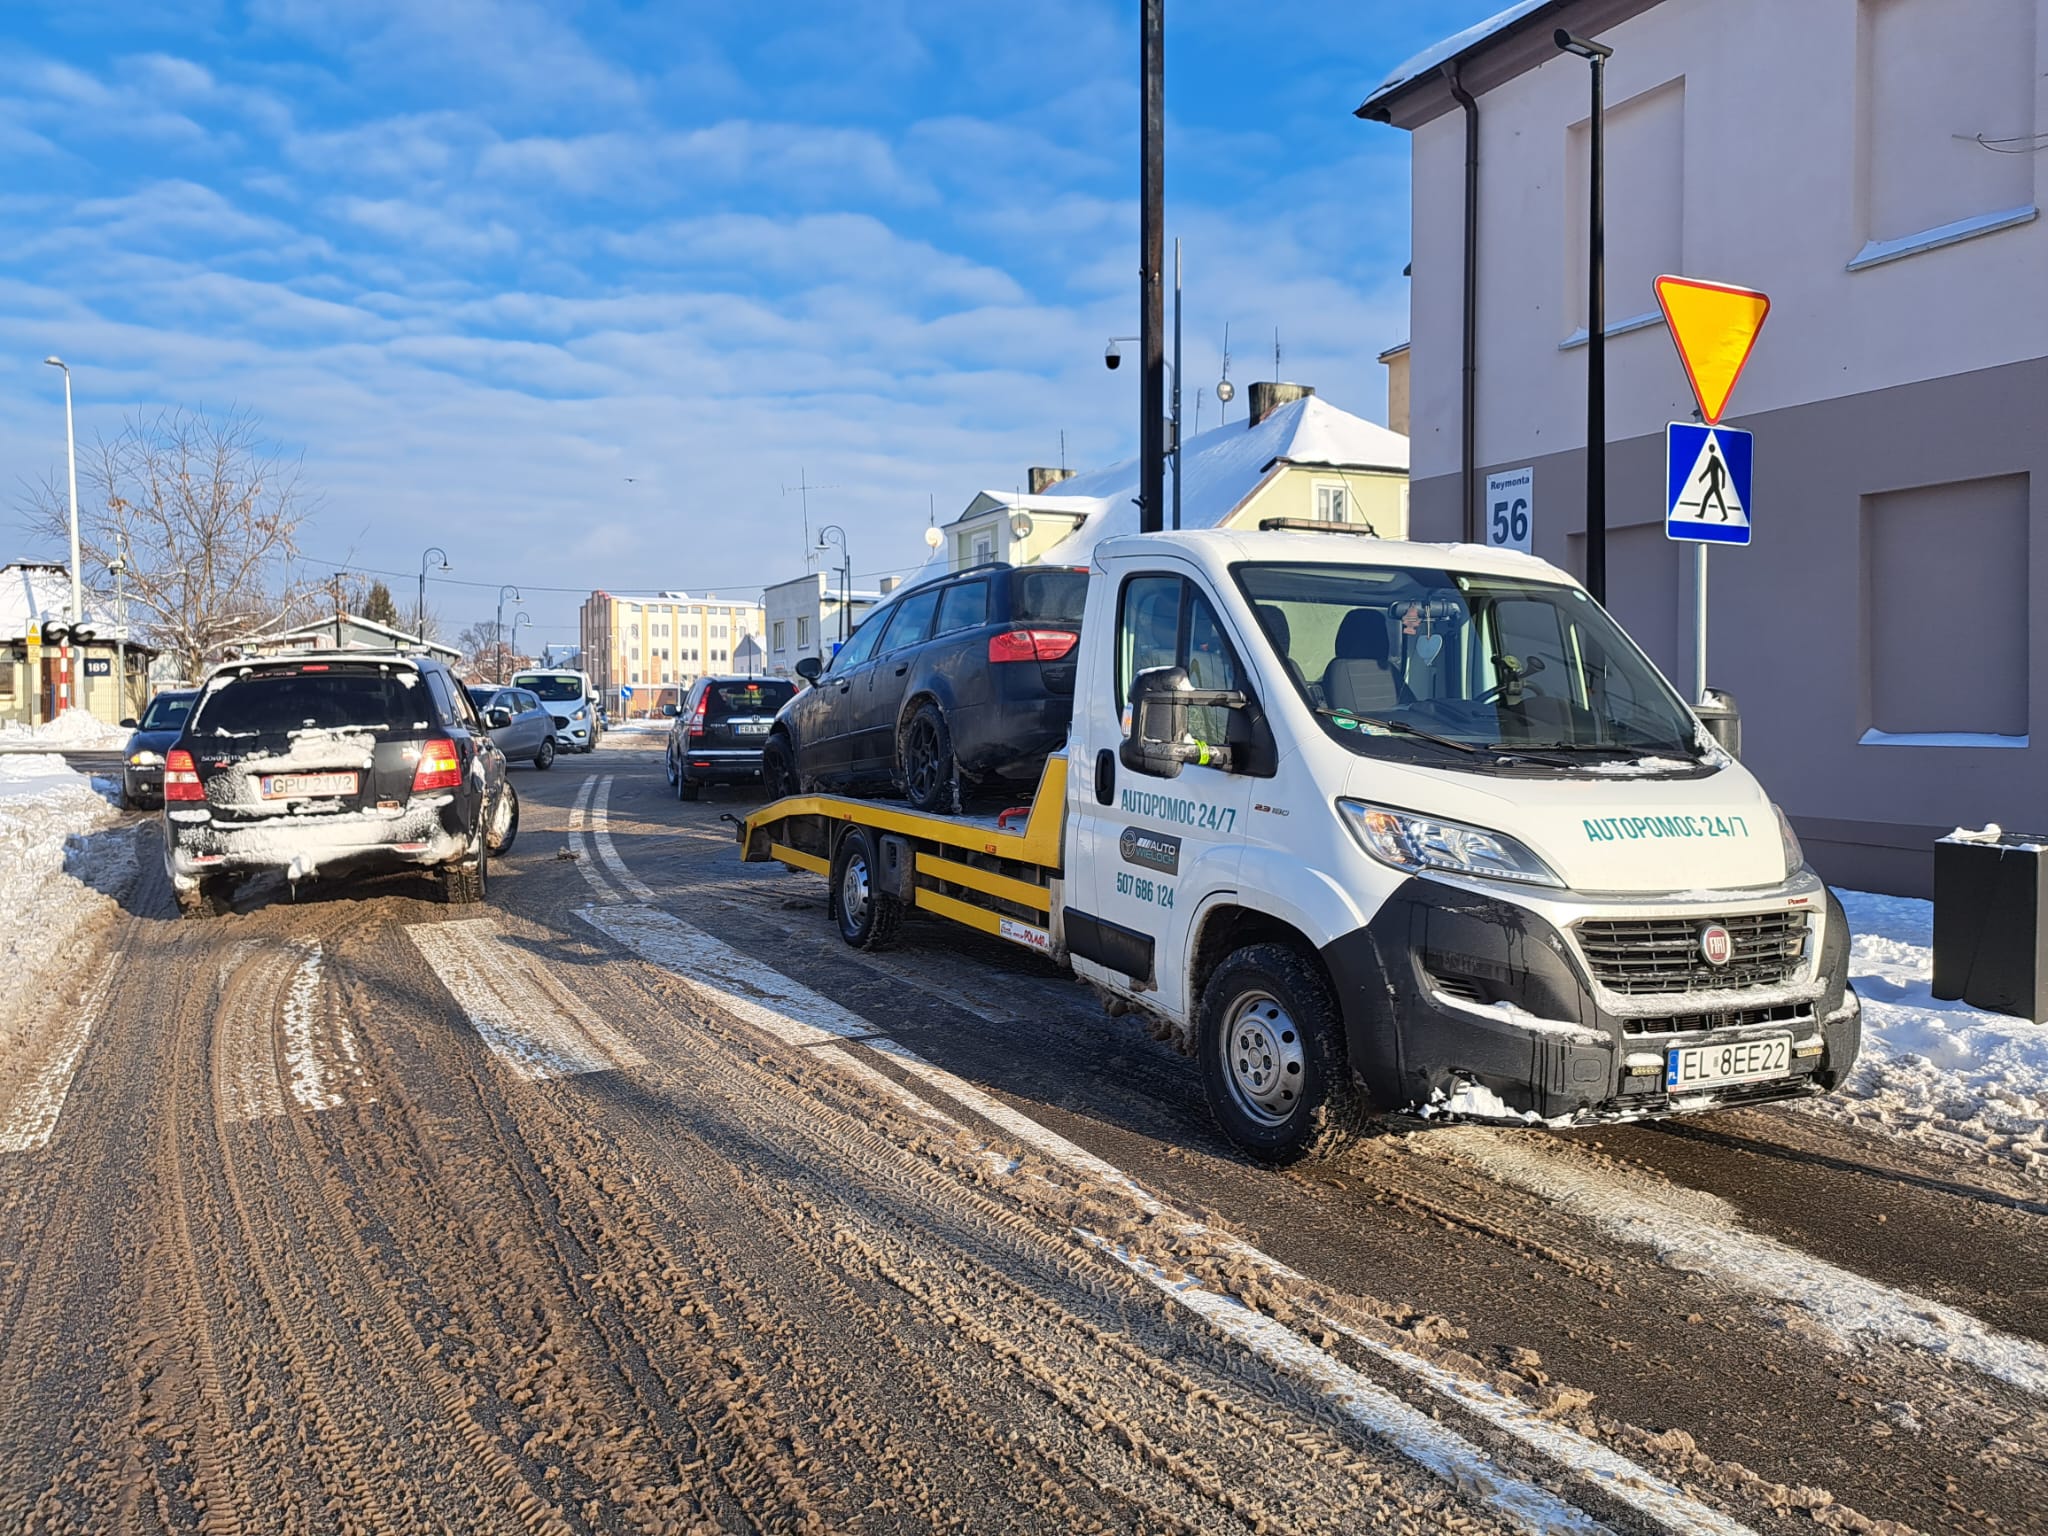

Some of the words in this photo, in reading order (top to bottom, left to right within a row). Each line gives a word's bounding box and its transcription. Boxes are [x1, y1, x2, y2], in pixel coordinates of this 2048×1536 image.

[1491, 476, 1530, 491] Reymonta
[1493, 498, 1528, 544] 56
[88, 663, 108, 673] 189
[273, 777, 306, 794] GPU
[1121, 789, 1195, 825] AUTOPOMOC
[1198, 803, 1236, 832] 24/7
[1582, 816, 1703, 842] AUTOPOMOC
[1700, 816, 1749, 838] 24/7
[1135, 848, 1175, 865] WIELOCH
[1150, 841, 1176, 856] AUTO
[1117, 872, 1134, 895] 507
[1135, 877, 1153, 903] 686
[1157, 884, 1174, 909] 124
[1708, 936, 1726, 955] FIAT
[1683, 1051, 1711, 1081] EL
[1720, 1042, 1786, 1076] 8EE22
